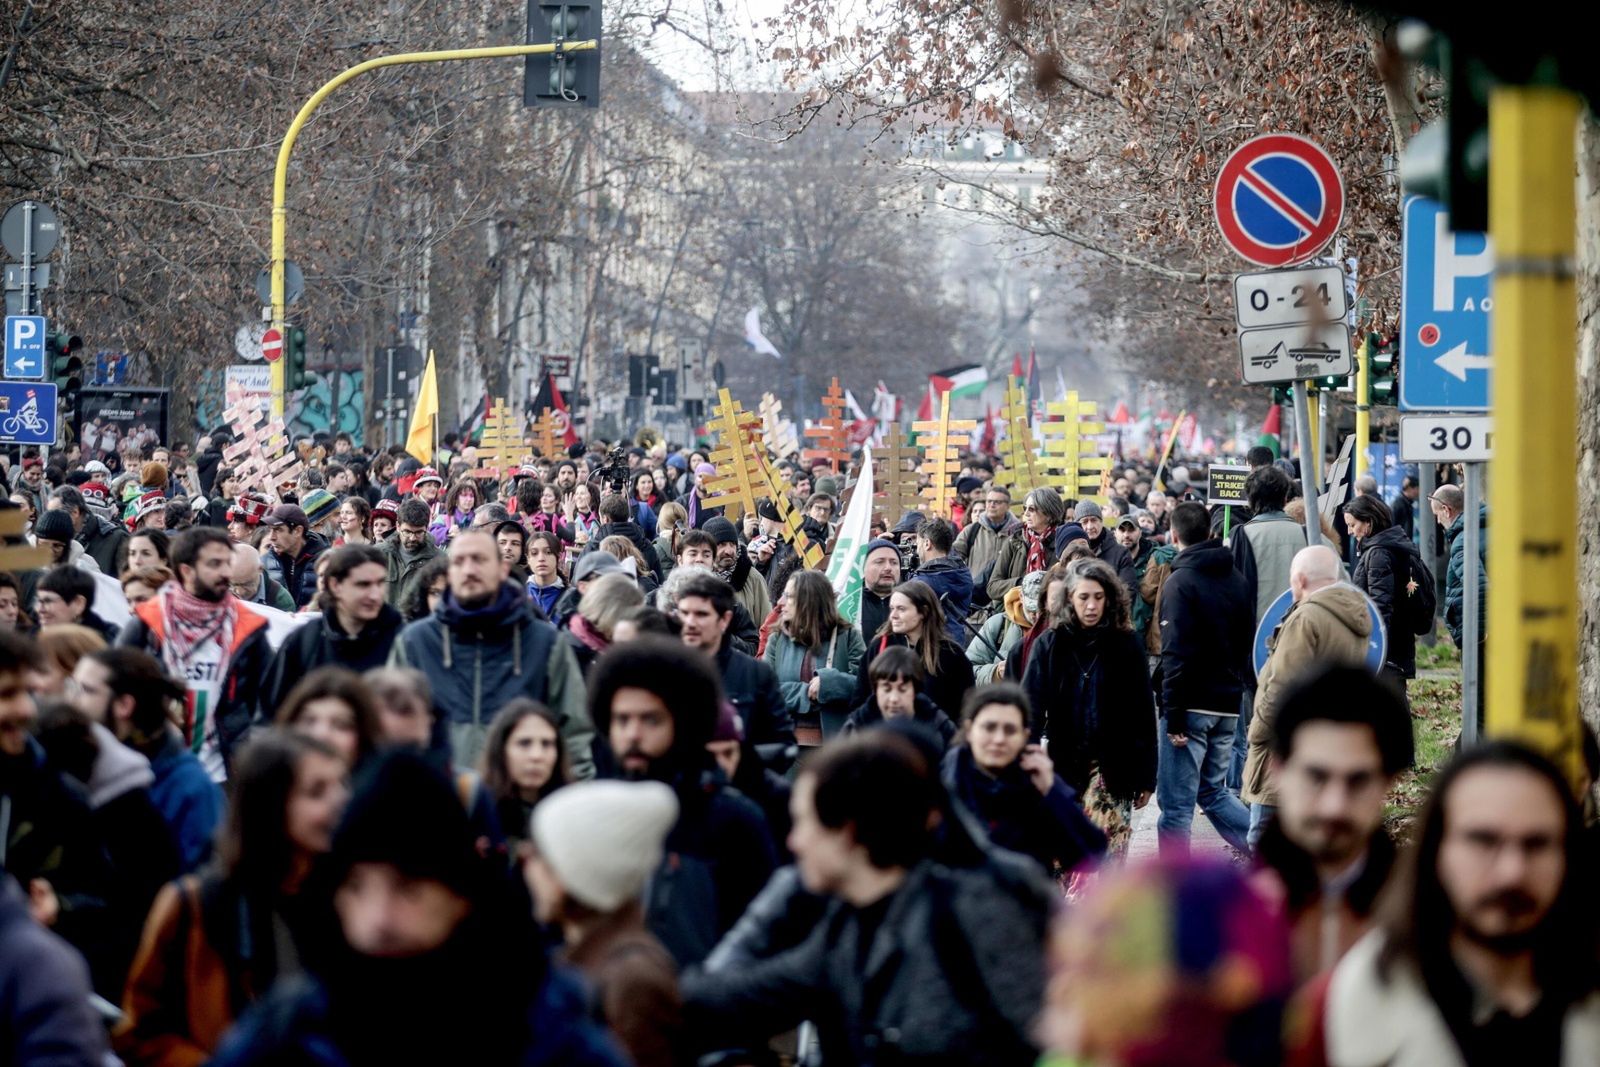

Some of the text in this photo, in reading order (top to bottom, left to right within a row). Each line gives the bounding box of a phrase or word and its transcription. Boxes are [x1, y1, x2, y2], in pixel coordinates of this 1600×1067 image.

[1433, 211, 1495, 312] P
[14, 319, 36, 350] P
[1220, 490, 1241, 498] BACK
